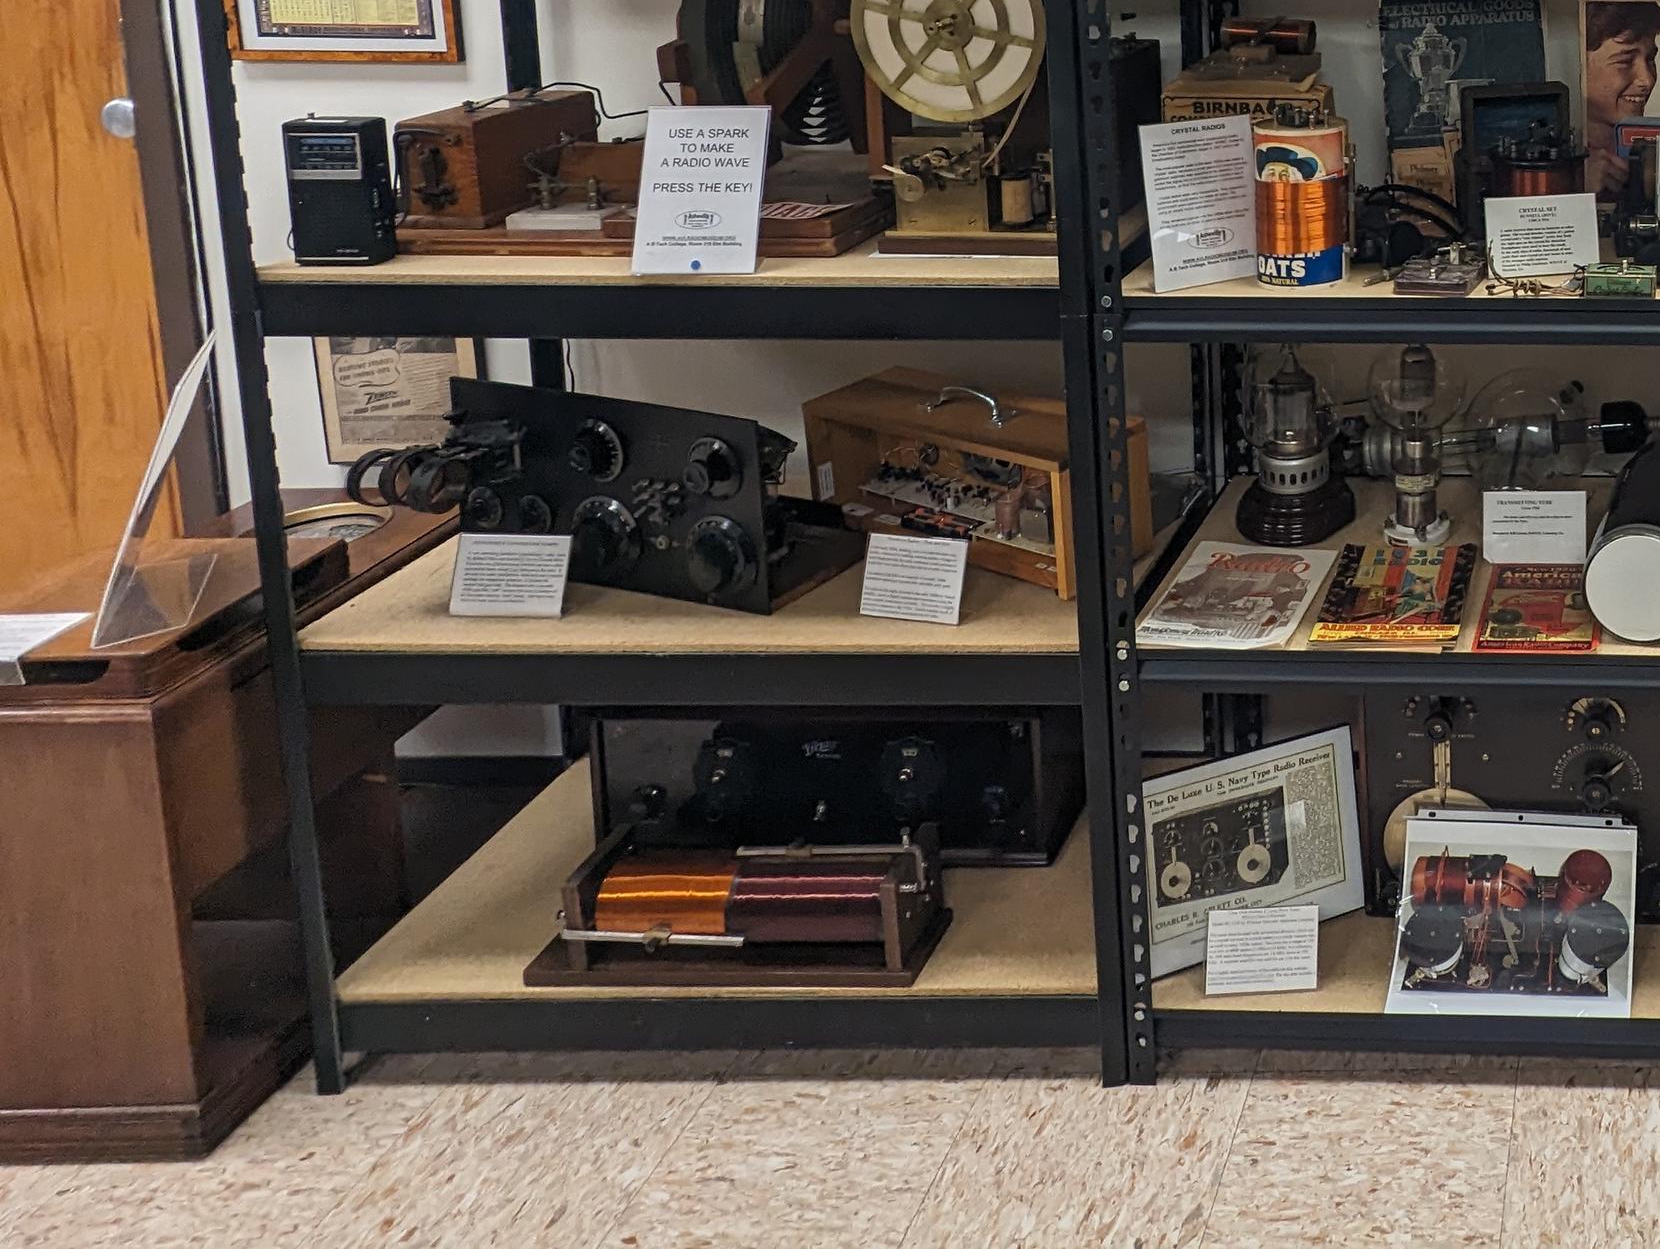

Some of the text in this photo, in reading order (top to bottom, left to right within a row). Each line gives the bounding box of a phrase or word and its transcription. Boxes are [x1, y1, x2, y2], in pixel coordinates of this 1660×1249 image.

[1383, 0, 1535, 17] ELECTRICAL GOODS
[1401, 11, 1535, 28] RADIO APPARATUS
[669, 129, 750, 138] USE A SPARK
[1171, 123, 1226, 135] CRYSTAL RADIOS
[681, 143, 734, 153] TO MAKE
[660, 158, 750, 167] A RADIO WAVE
[653, 183, 752, 192] PRESS THE KEY!
[1258, 259, 1306, 278] OATS
[1147, 798, 1164, 809] The
[1167, 795, 1179, 805] De
[1182, 789, 1203, 801] Luxe
[1217, 780, 1226, 790] S.
[1228, 775, 1249, 787] Navy
[1252, 770, 1271, 780] Type
[1273, 761, 1296, 774] Radio
[1298, 752, 1331, 767] Receiver
[1155, 914, 1190, 931] CHARLES
